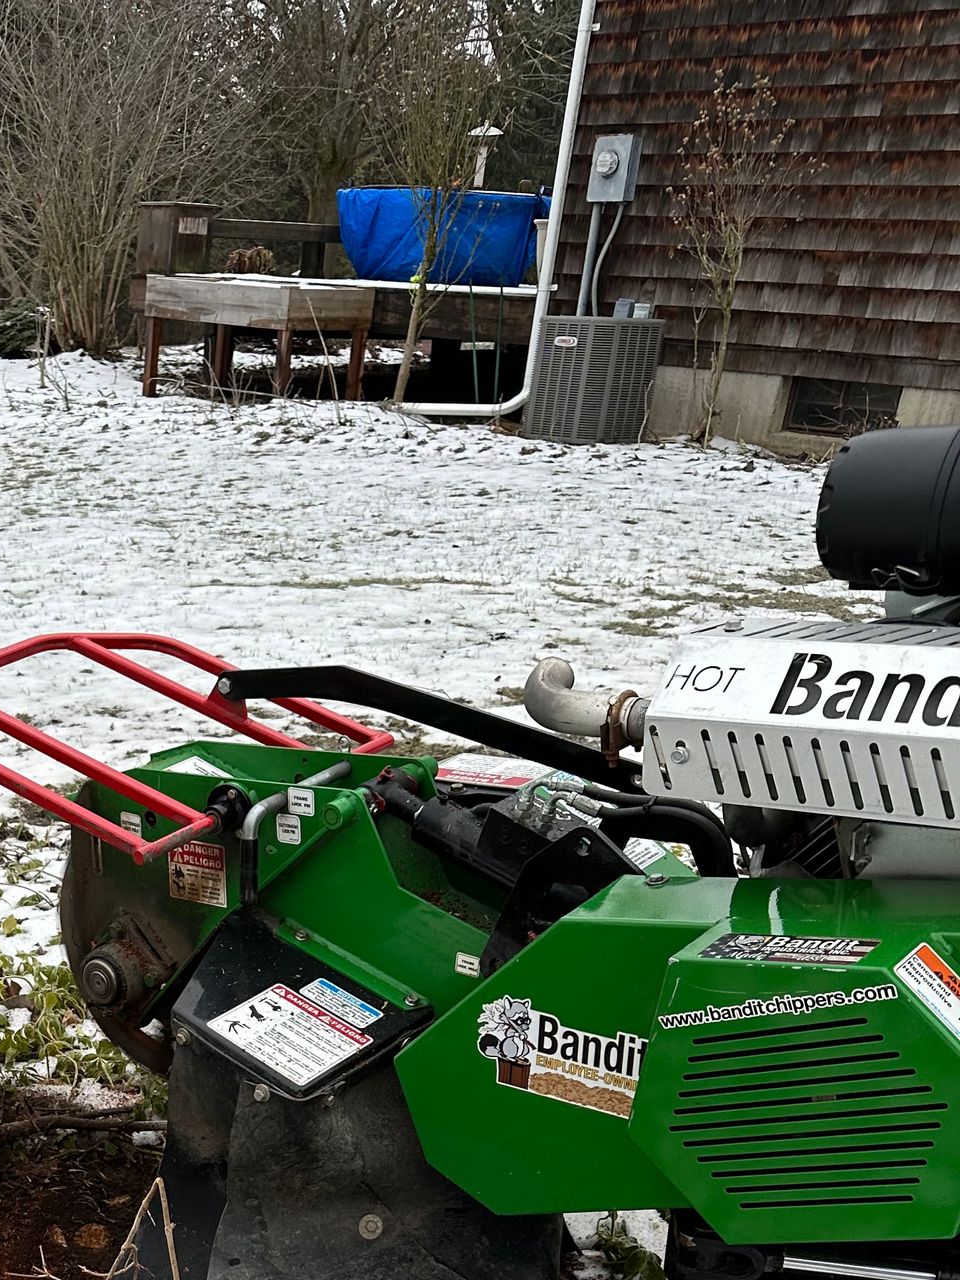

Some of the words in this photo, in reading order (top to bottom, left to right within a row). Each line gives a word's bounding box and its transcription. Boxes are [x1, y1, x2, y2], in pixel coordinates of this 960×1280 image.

[665, 664, 745, 693] HOT
[183, 844, 220, 857] DANGER
[183, 854, 221, 869] PELIGRO
[767, 936, 860, 951] Bandit
[902, 964, 922, 986] Harm
[907, 960, 953, 1008] Reproductive
[912, 956, 937, 982] Cancer
[936, 982, 952, 997] and
[286, 992, 320, 1015] DANGER
[660, 985, 897, 1028] www.banditchippers.com
[331, 1019, 367, 1043] PELIGRO
[537, 1014, 649, 1077] Bandit
